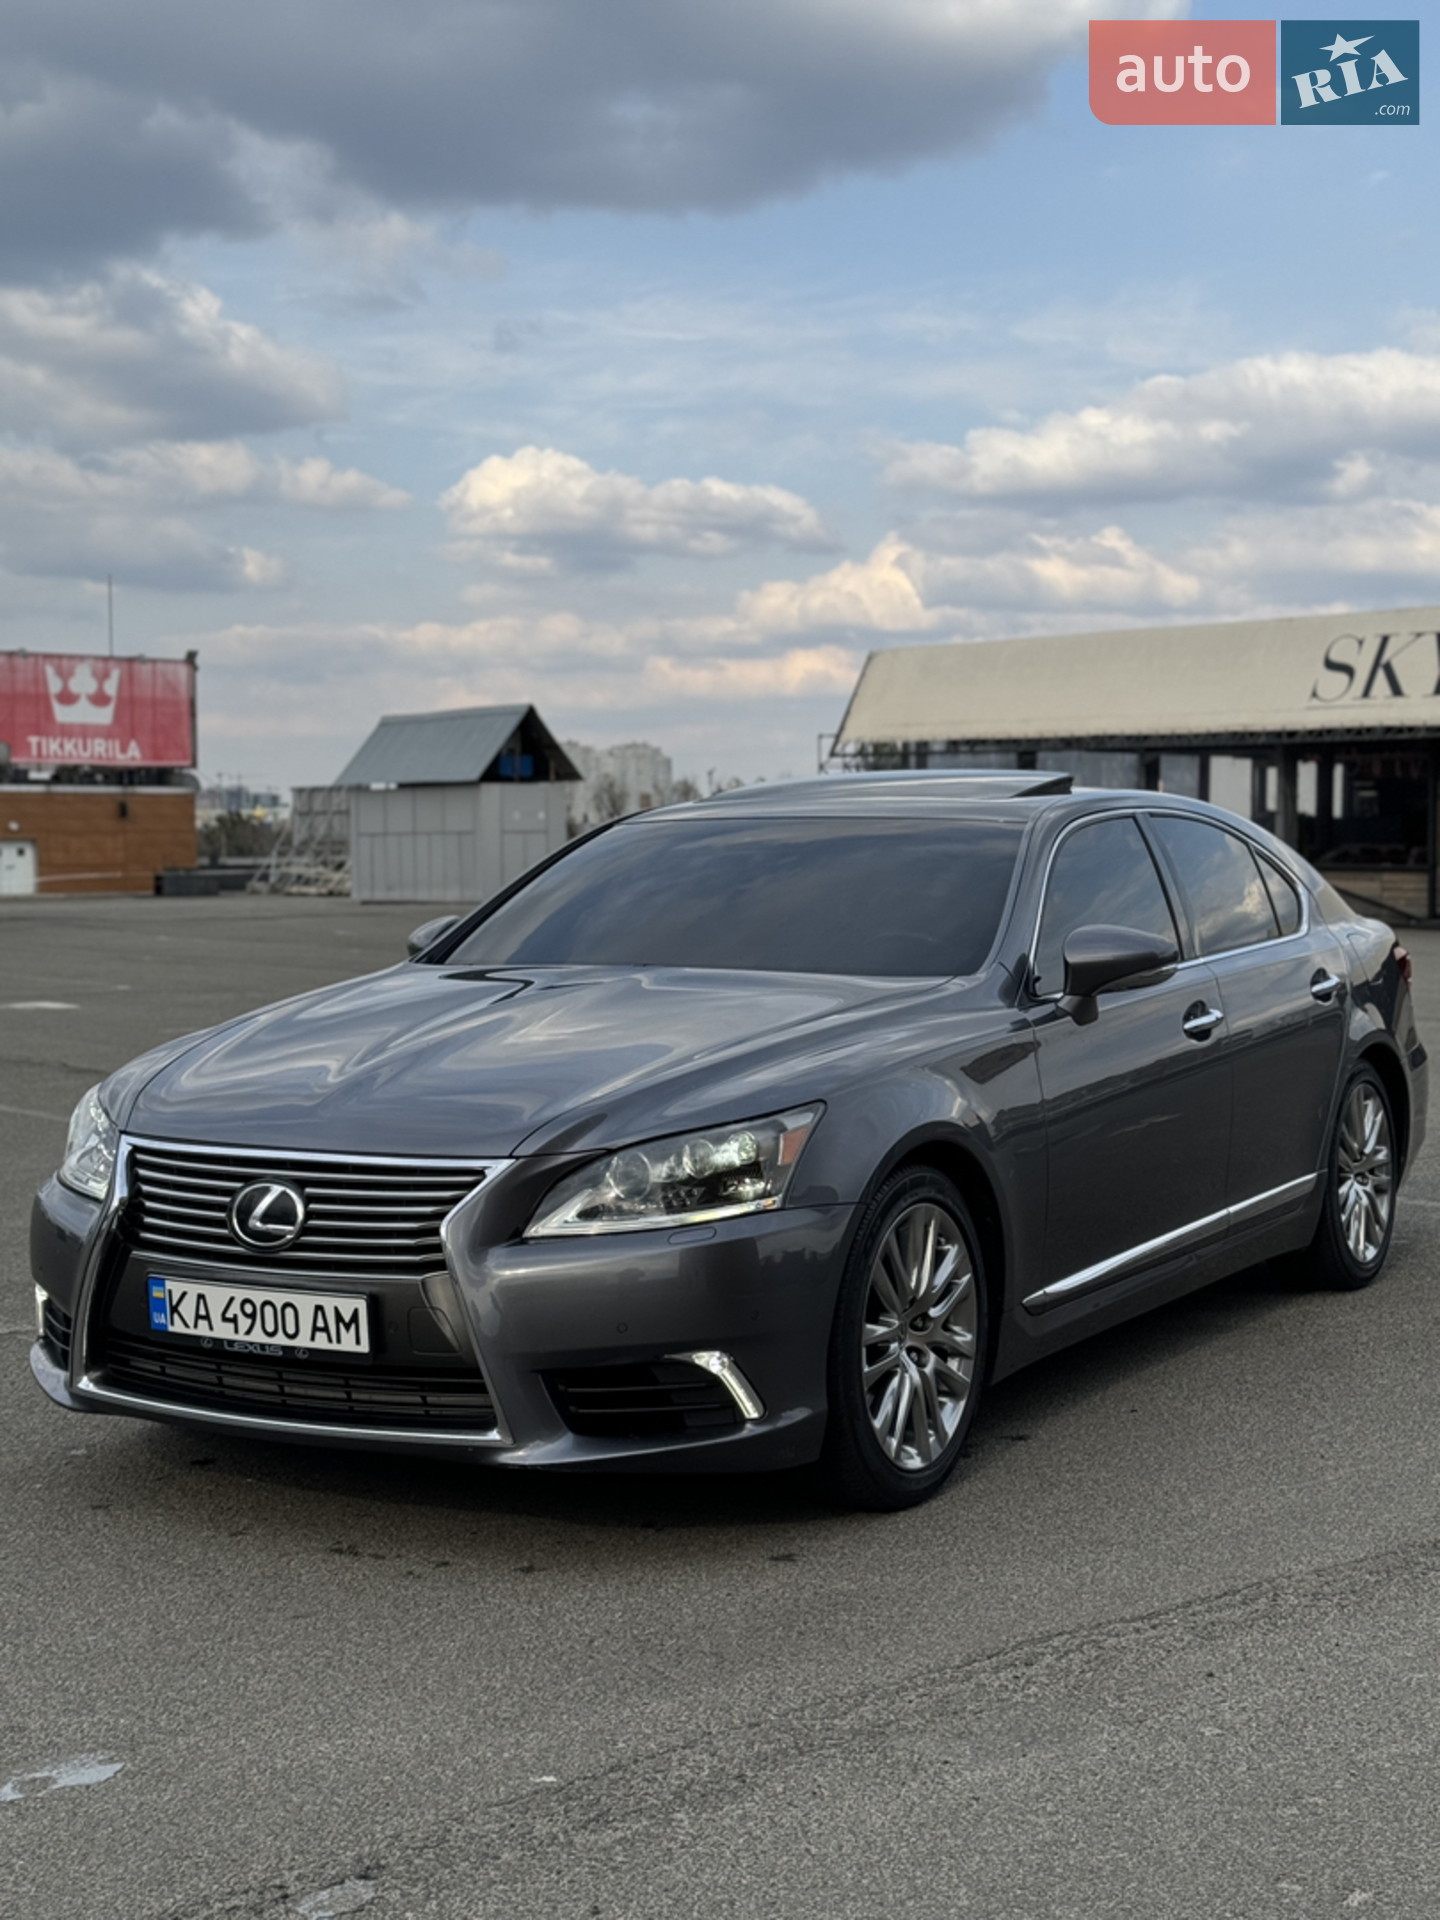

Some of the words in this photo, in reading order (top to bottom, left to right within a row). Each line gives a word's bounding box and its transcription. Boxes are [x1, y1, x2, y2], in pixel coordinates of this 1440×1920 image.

[27, 735, 142, 760] TIKKURILA
[152, 1311, 167, 1325] UA
[167, 1288, 214, 1331] KA
[220, 1296, 301, 1341] 4900
[309, 1303, 362, 1346] AM
[223, 1339, 284, 1357] LEXUS
